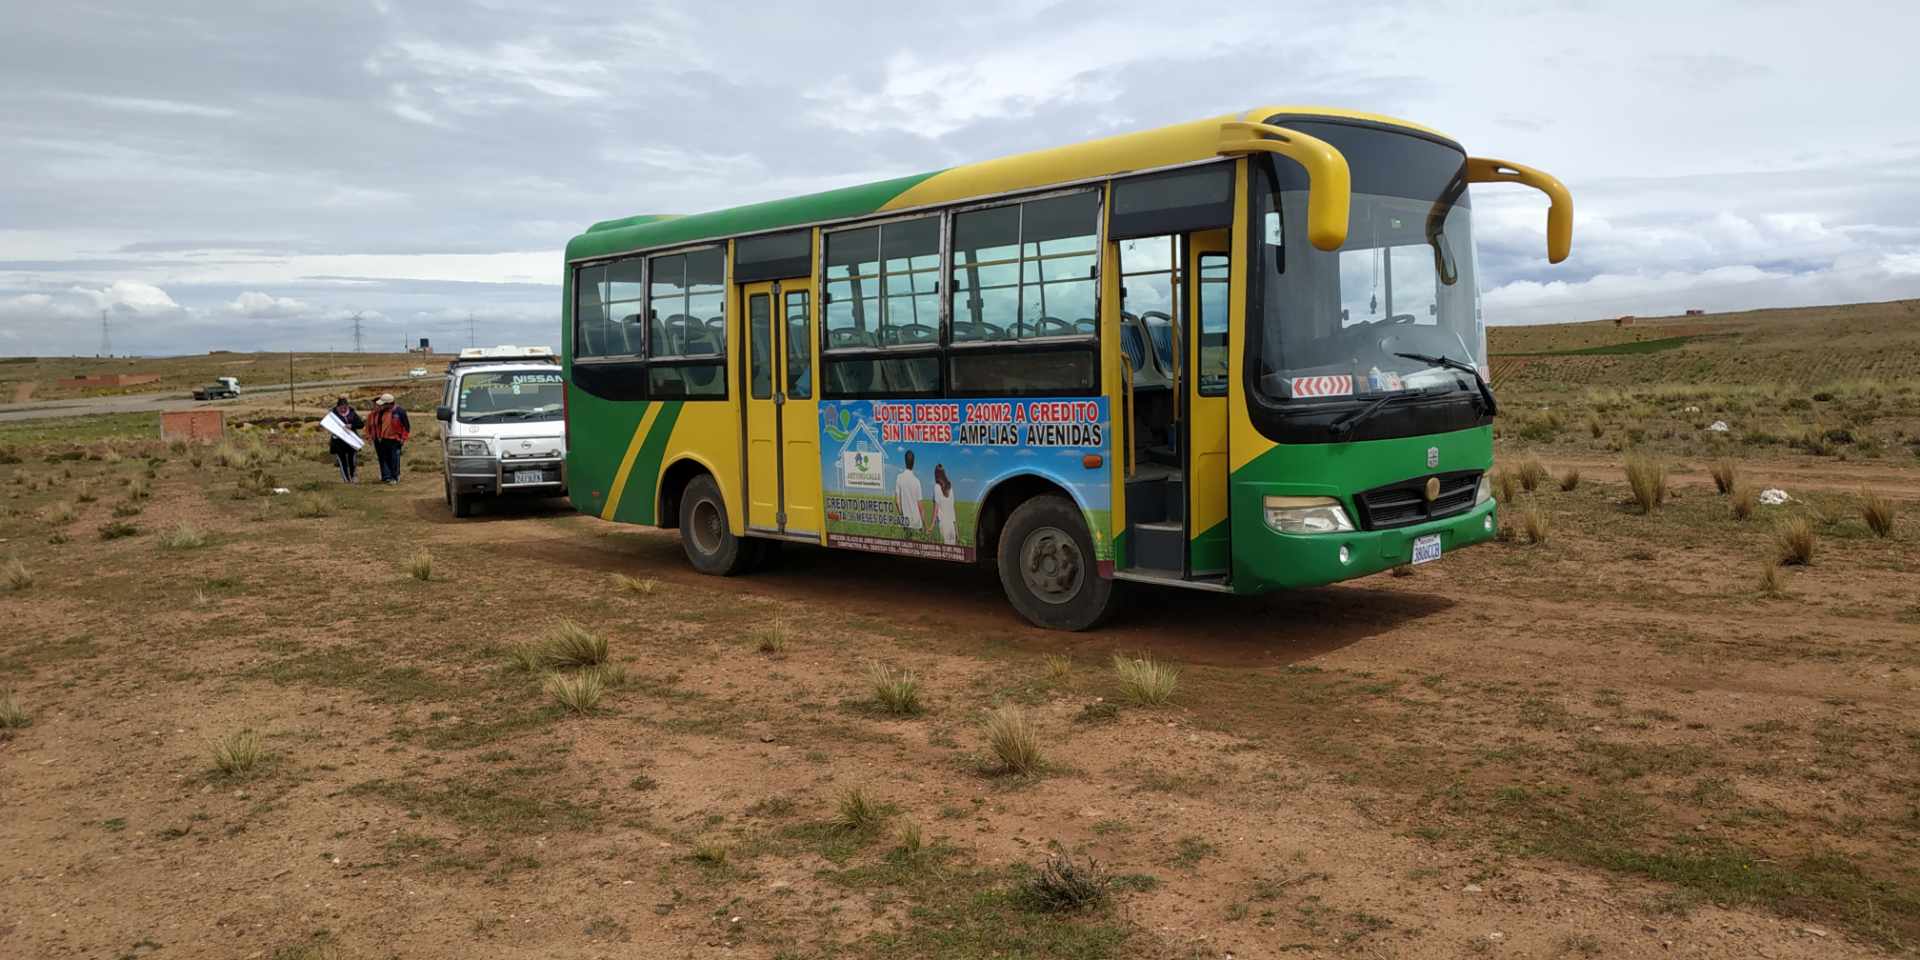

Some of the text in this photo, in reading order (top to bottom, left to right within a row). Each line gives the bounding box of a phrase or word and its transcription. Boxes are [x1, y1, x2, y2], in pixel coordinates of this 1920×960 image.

[512, 374, 563, 384] NISSAN
[873, 401, 1099, 423] LOTES DESDE 240M2 A CREDITO
[882, 423, 1102, 447] SIN INTERES AMPLIAS AVENIDAS
[826, 496, 894, 513] CREDITO DIRECTO
